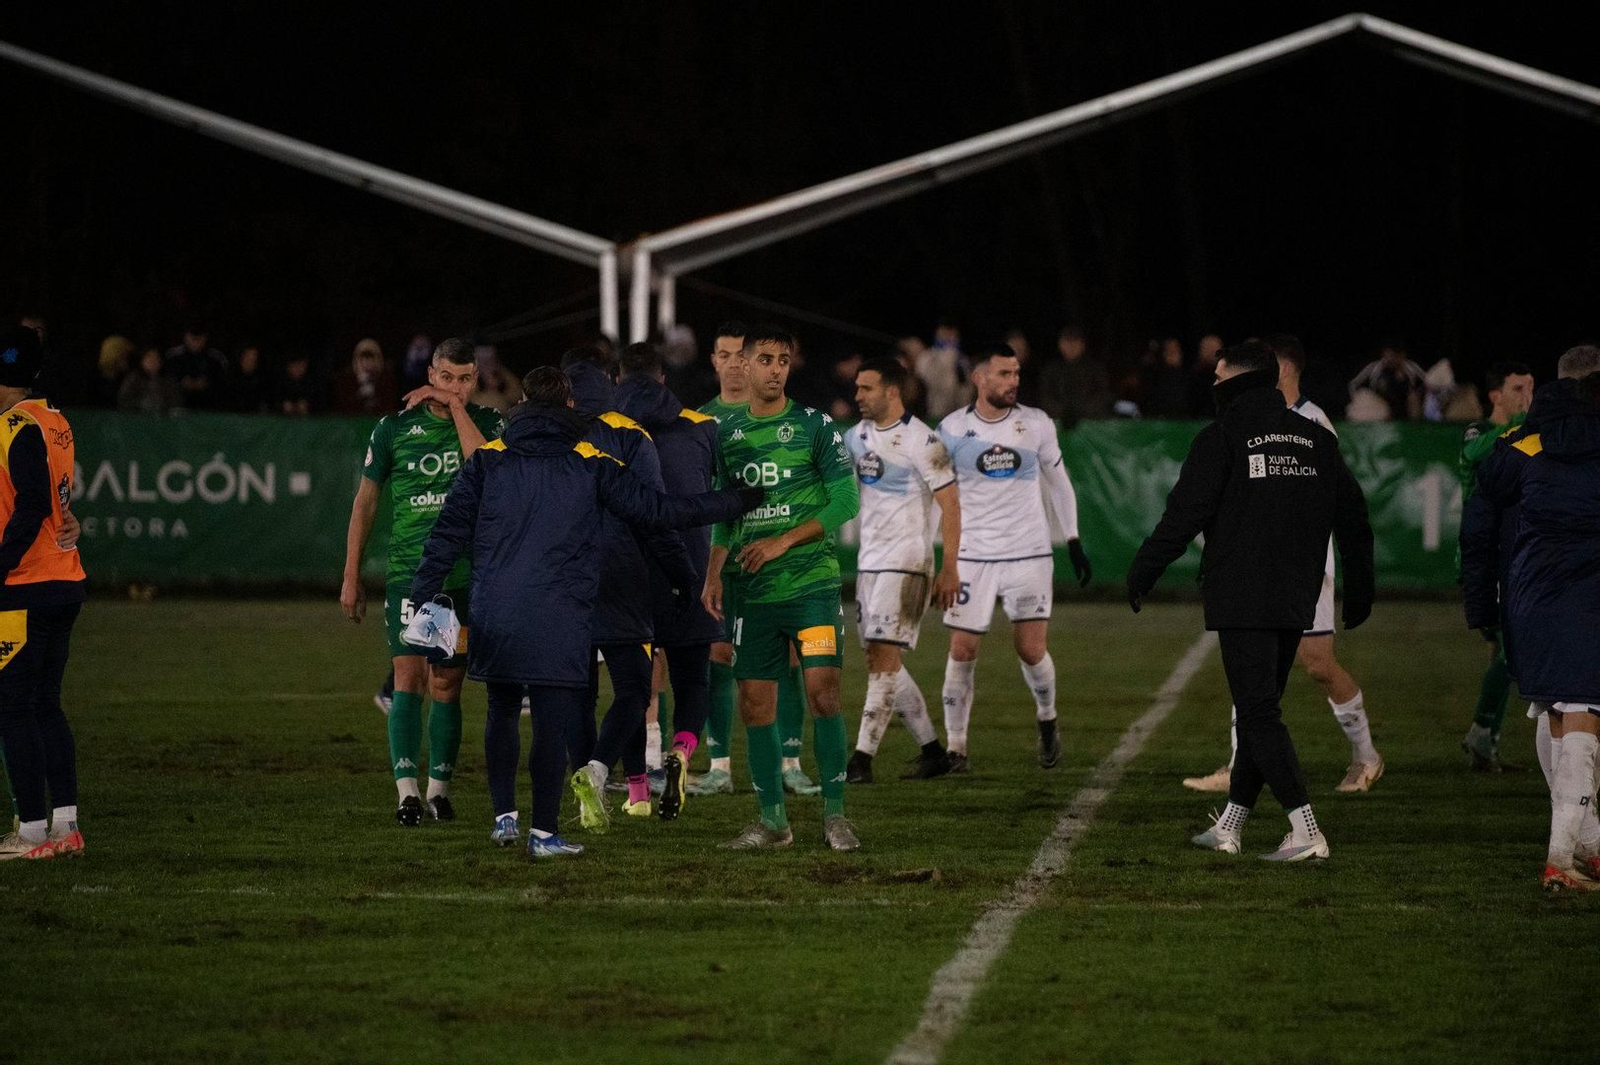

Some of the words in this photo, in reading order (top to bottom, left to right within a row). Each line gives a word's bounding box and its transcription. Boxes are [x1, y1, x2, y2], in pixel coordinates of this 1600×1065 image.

[1268, 455, 1299, 466] XUNTA
[1268, 465, 1281, 476] DE
[1282, 466, 1318, 477] GALICIA
[400, 598, 415, 626] 5
